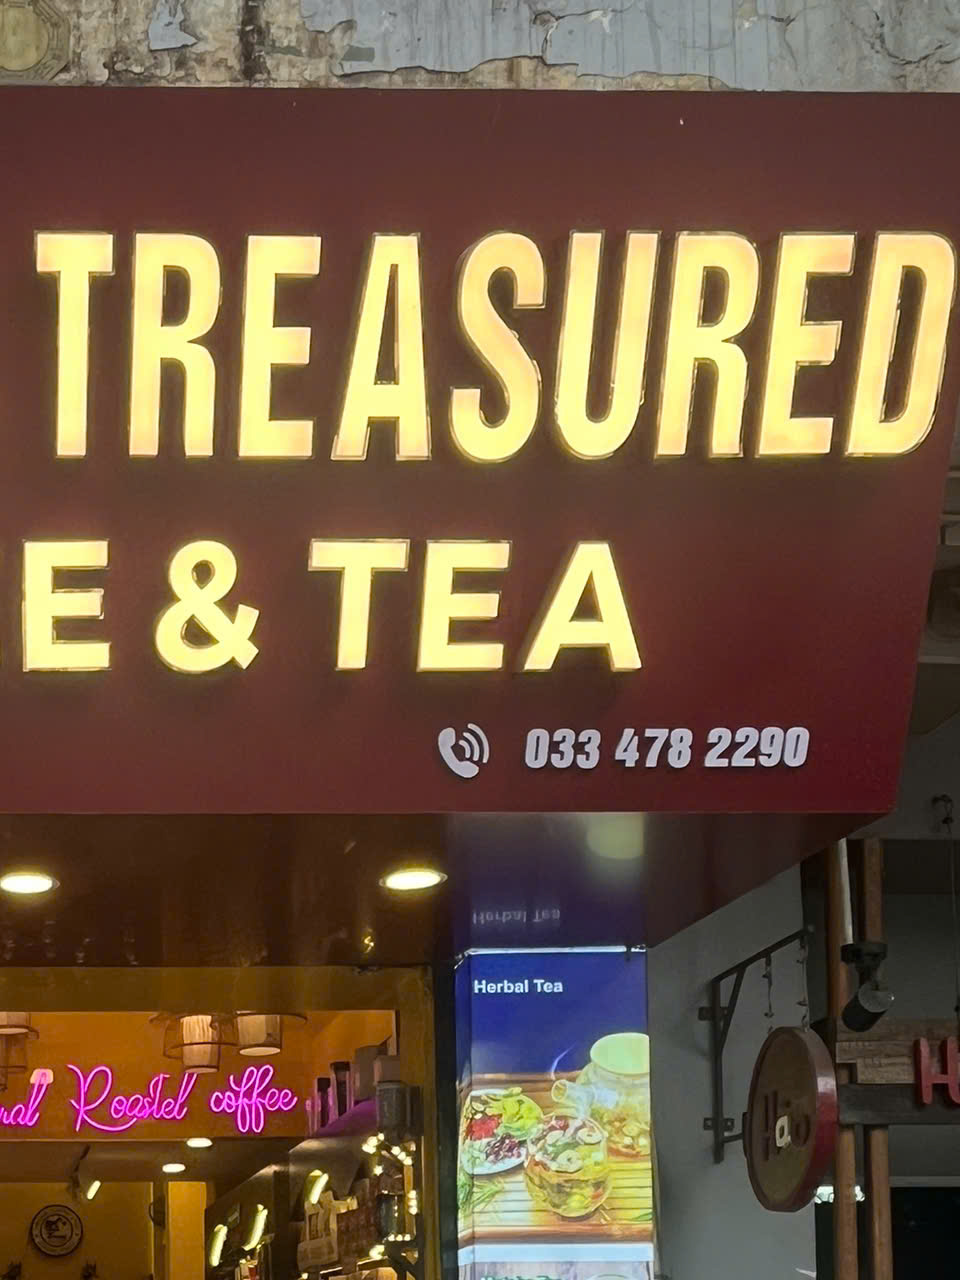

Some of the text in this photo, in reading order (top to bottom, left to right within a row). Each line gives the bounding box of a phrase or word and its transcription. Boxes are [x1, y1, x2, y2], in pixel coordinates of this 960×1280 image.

[34, 230, 957, 463] TREASURED
[154, 538, 260, 675] &
[308, 537, 643, 674] TEA
[524, 726, 811, 769] 033 478 2290
[473, 978, 564, 994] Herbal Tea
[209, 1063, 298, 1134] coffee
